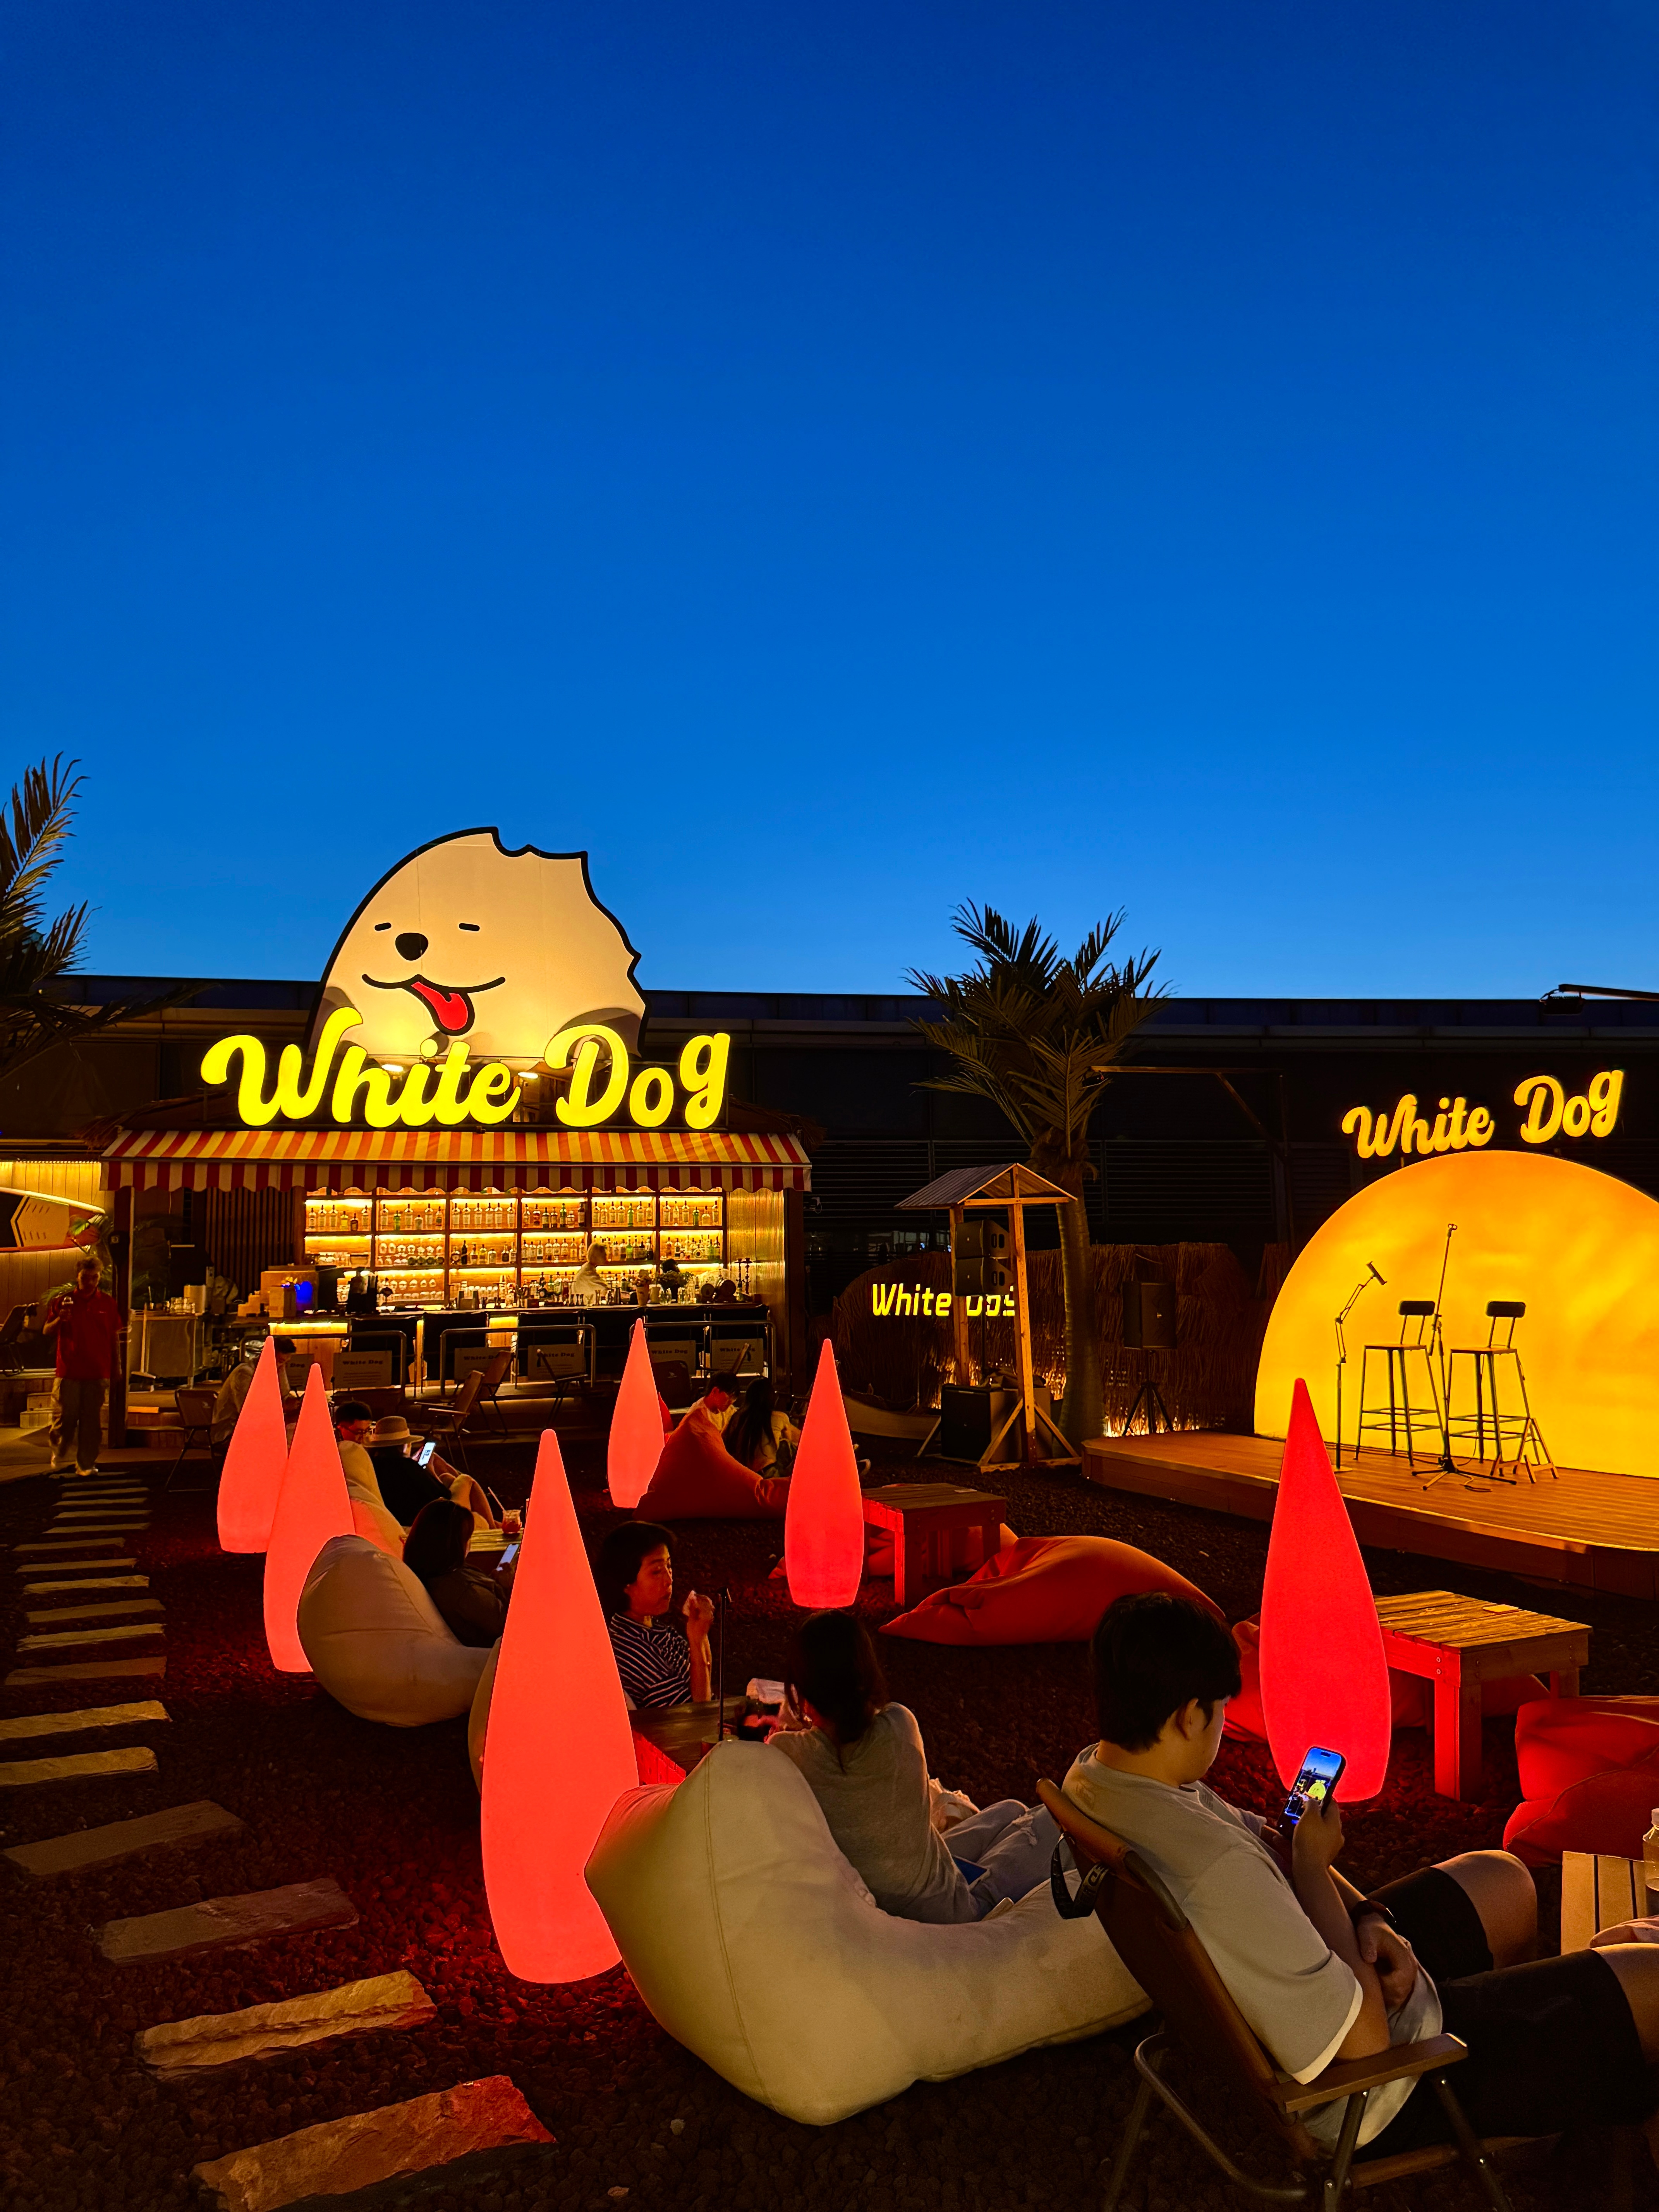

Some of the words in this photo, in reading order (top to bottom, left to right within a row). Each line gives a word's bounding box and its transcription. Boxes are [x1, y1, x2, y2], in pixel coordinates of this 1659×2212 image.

[201, 1007, 521, 1128] White
[544, 1024, 730, 1129] Dog
[1341, 1094, 1494, 1158] White
[1514, 1070, 1623, 1144] Dog
[872, 1283, 952, 1316] White
